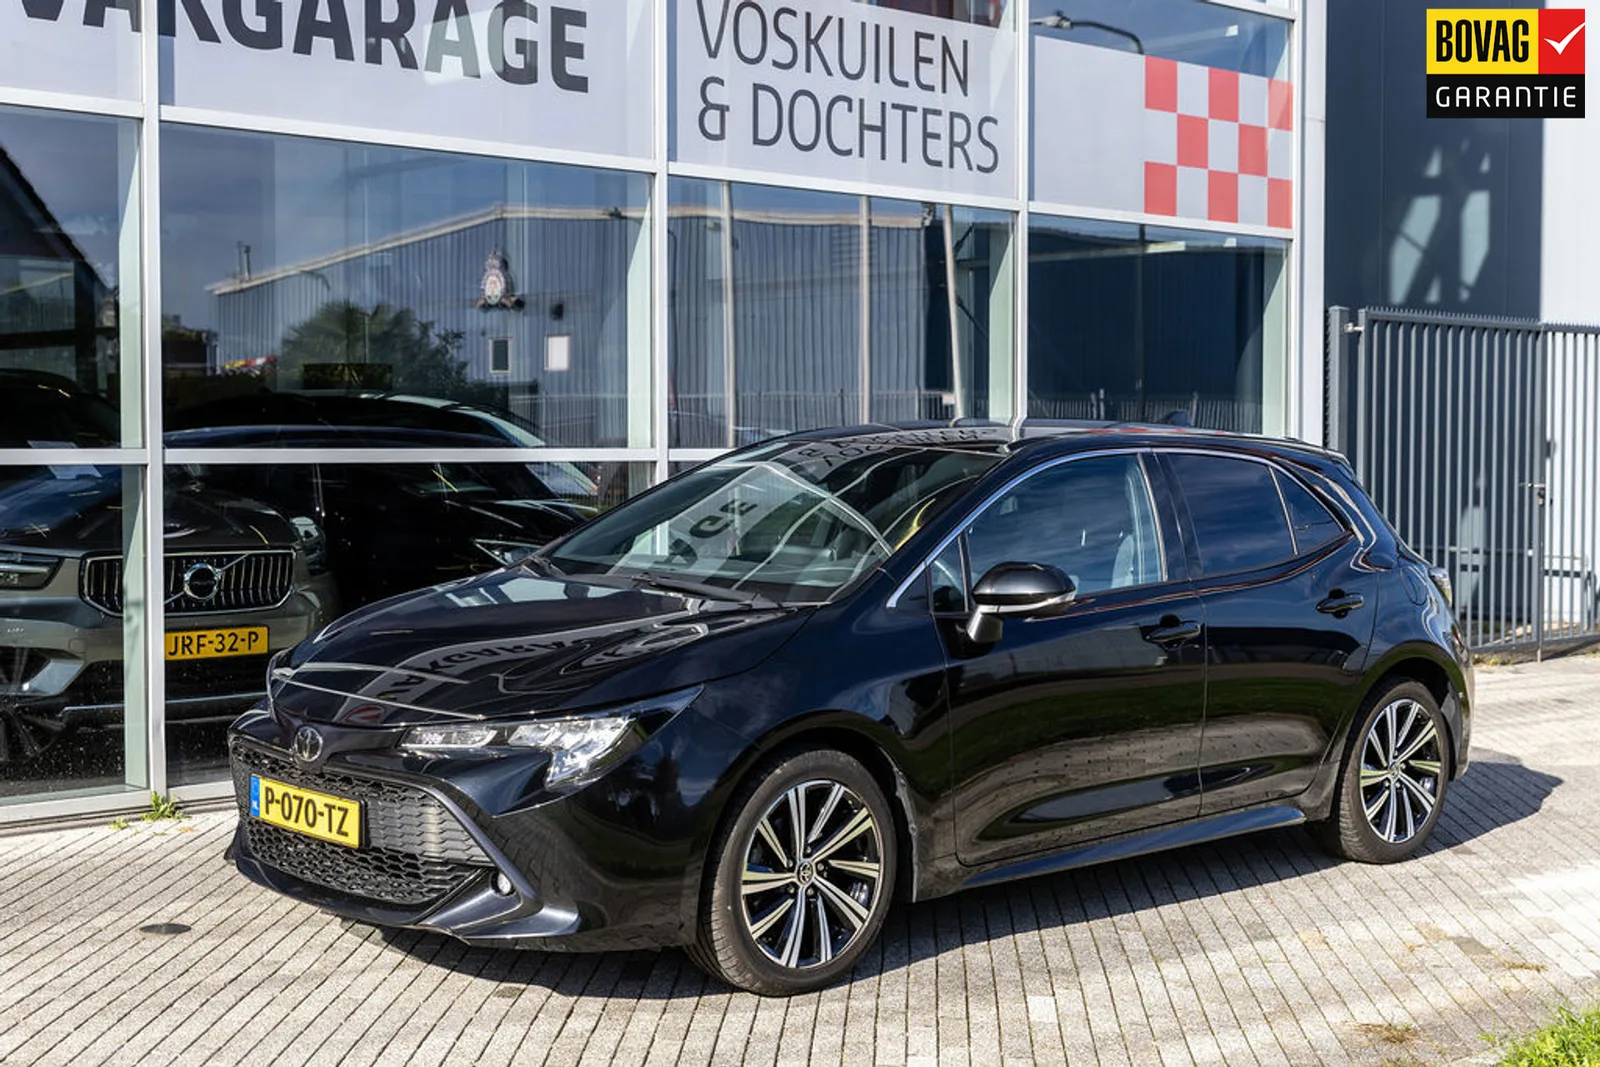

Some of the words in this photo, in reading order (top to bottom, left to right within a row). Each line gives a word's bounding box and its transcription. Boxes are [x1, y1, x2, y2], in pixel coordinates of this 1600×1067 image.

[21, 0, 589, 94] GARAGE
[697, 0, 969, 97] VOSKUILEN
[698, 76, 730, 141] &
[752, 83, 999, 173] DOCHTERS
[168, 631, 259, 656] JRF-32-P
[264, 786, 349, 837] P-070-TZ
